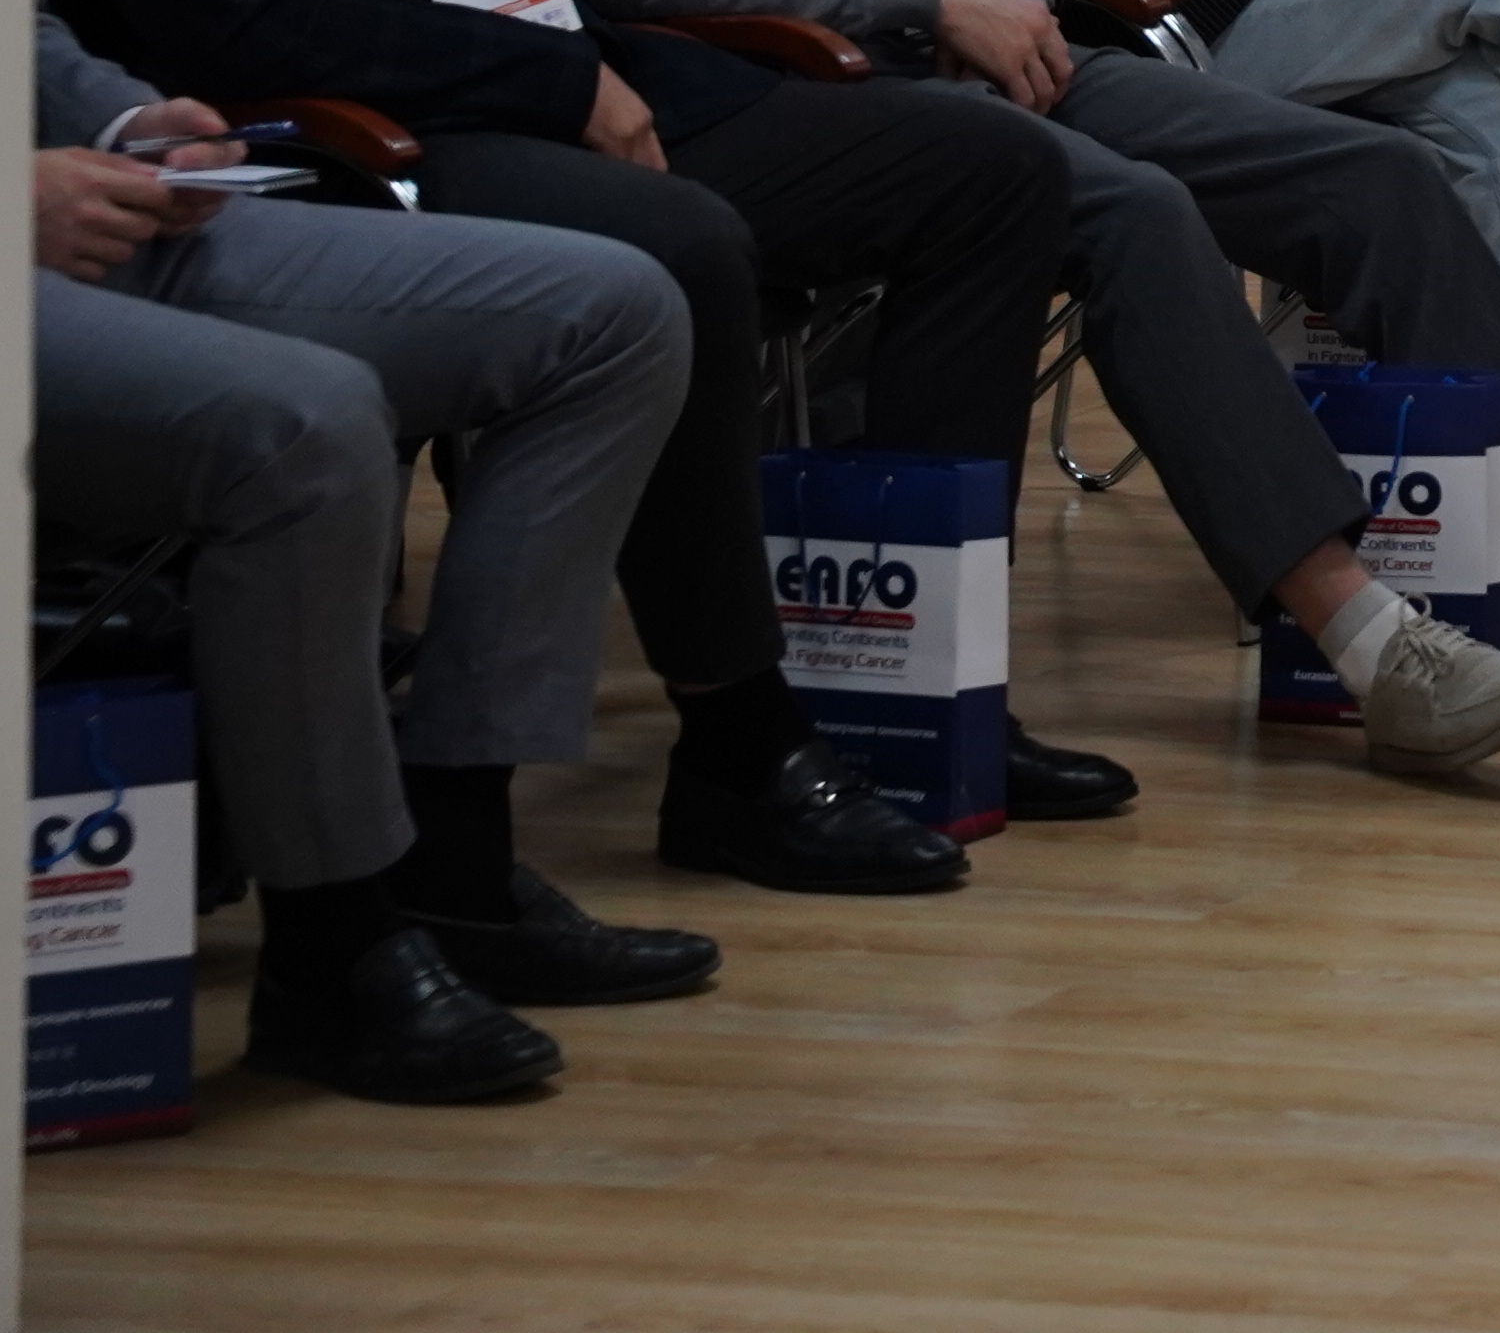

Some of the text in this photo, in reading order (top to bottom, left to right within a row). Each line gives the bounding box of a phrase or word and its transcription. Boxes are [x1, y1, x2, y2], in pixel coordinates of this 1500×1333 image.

[1307, 333, 1341, 345] Unitin
[1308, 350, 1319, 361] in
[1349, 471, 1442, 516] FO
[1360, 537, 1436, 551] Continents
[1384, 557, 1434, 572] Cancer
[776, 554, 917, 609] EAFO
[832, 630, 910, 650] Continents
[797, 648, 906, 669] Fighting Cancer
[33, 810, 134, 873] FO
